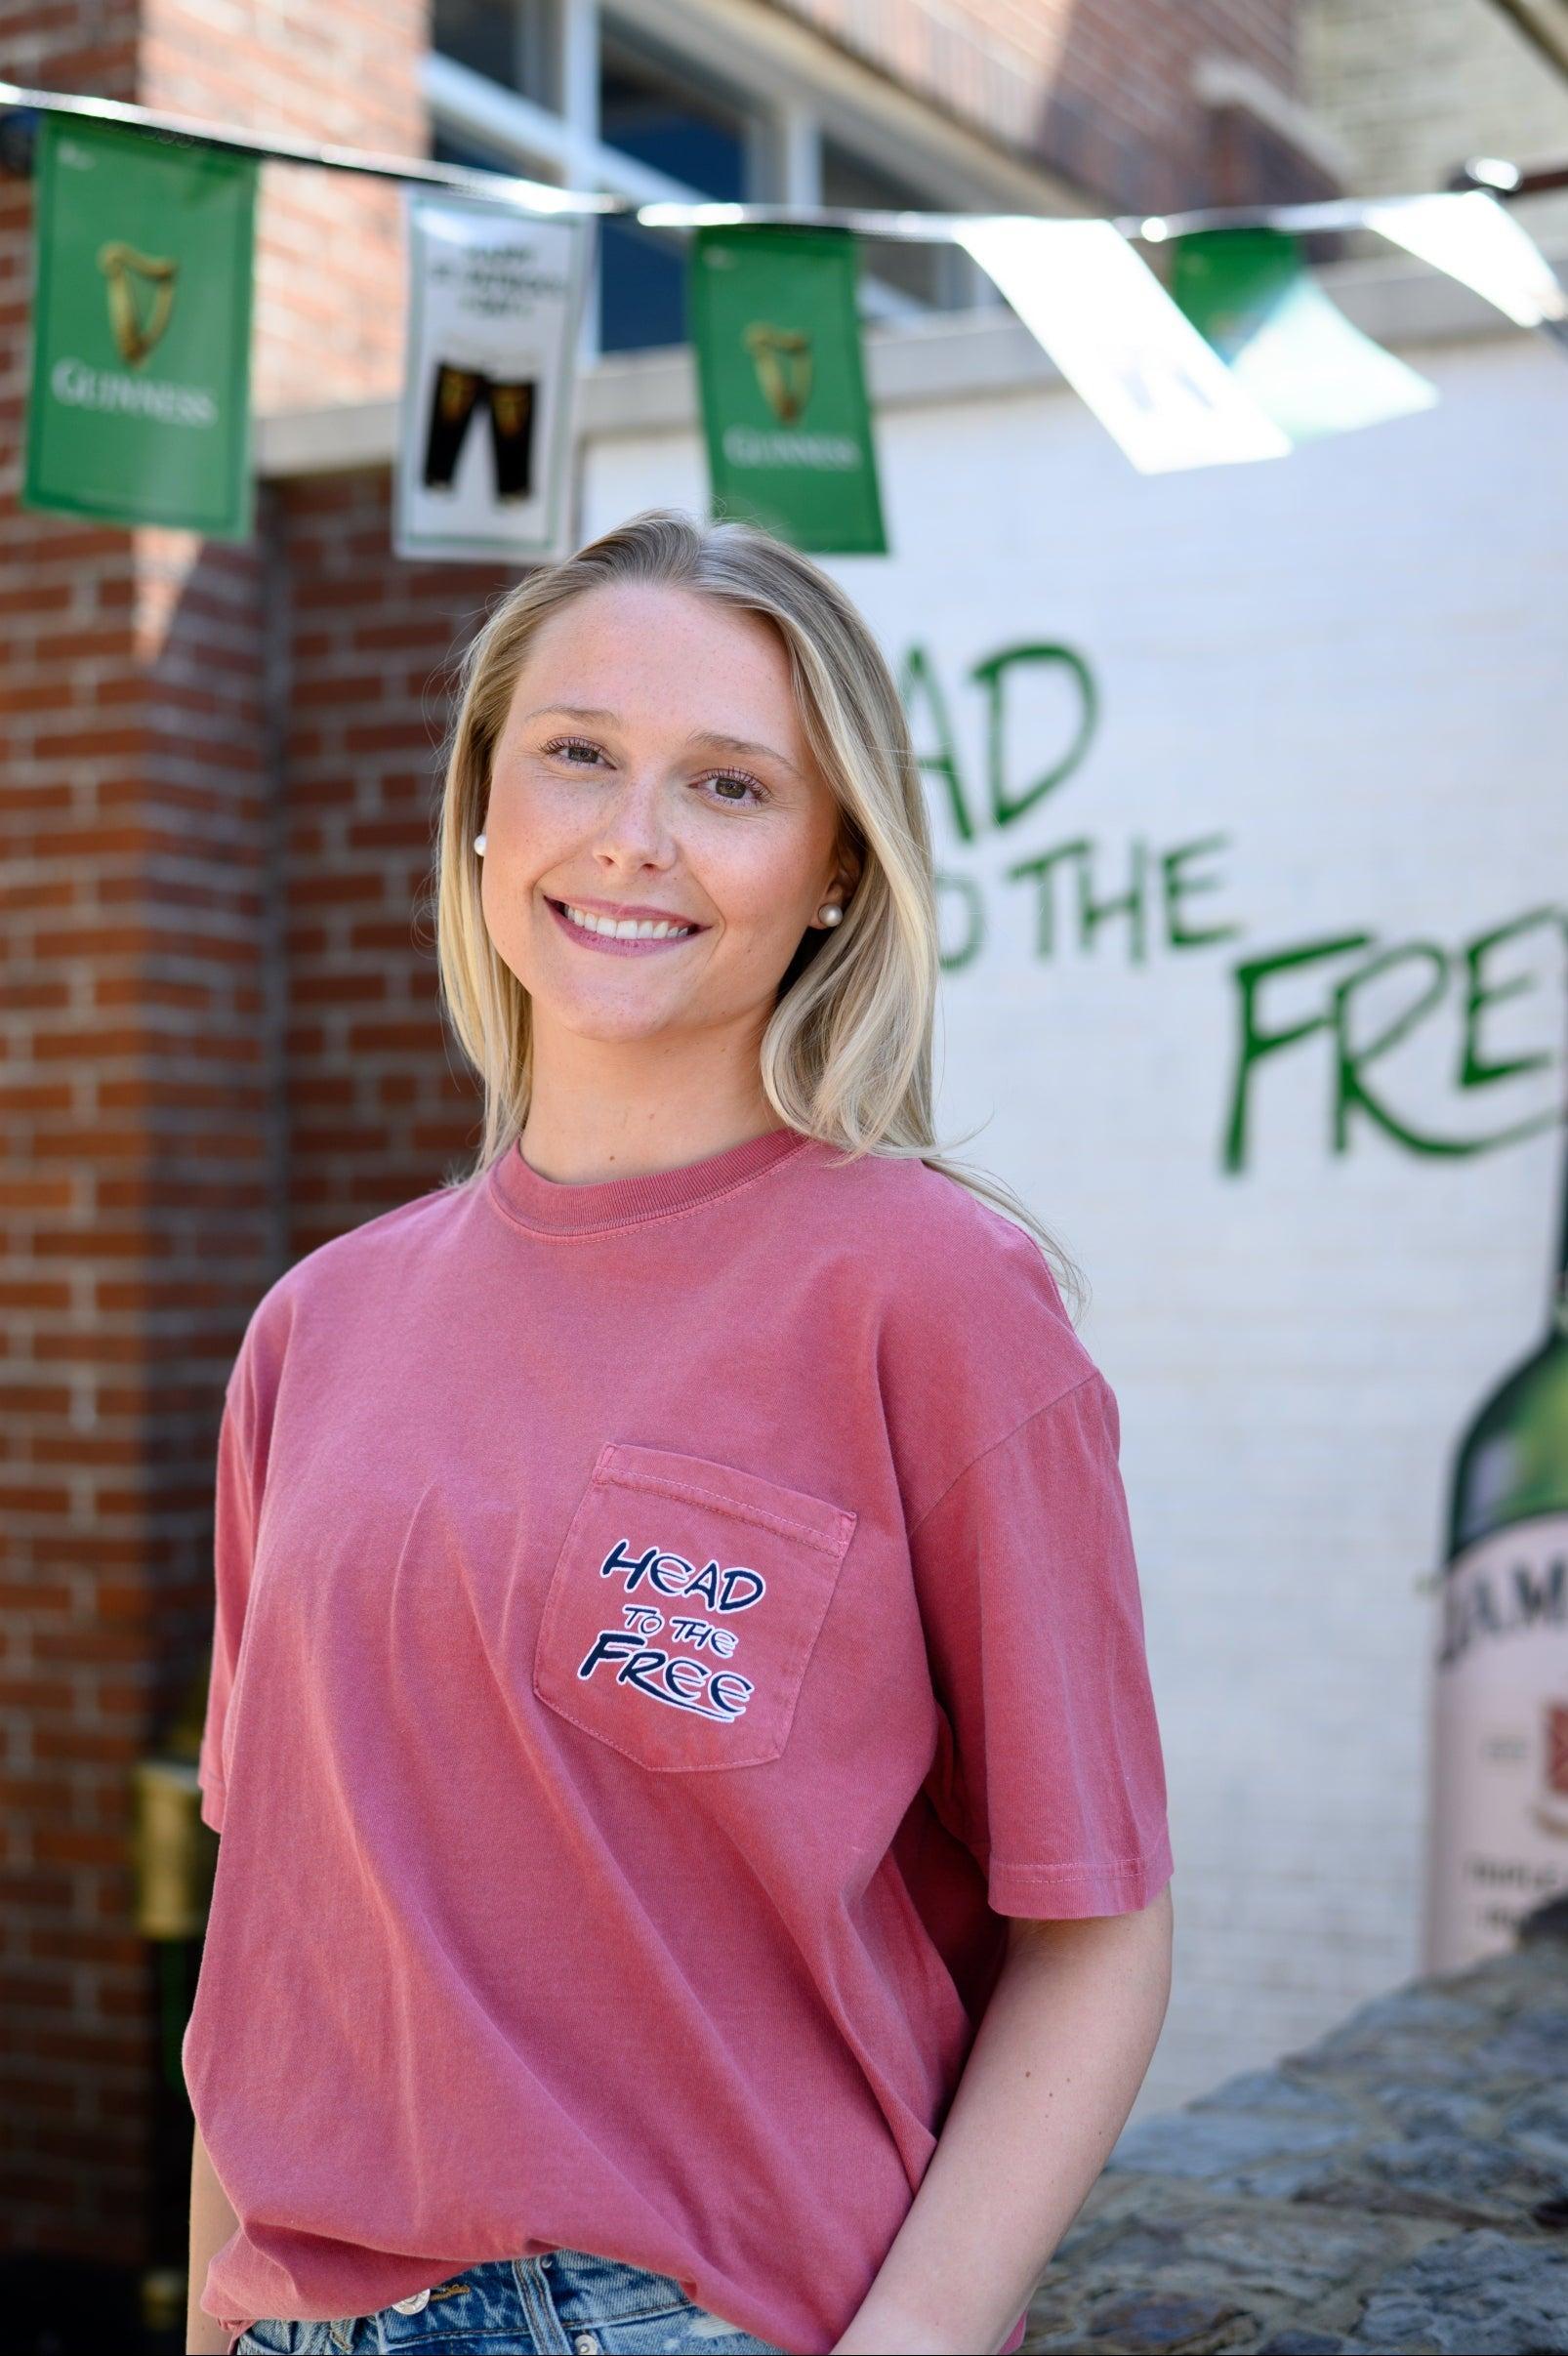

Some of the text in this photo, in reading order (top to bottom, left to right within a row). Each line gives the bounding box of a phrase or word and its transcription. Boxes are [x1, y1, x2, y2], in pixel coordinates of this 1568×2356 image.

[51, 358, 219, 429] GUINNESS
[1005, 830, 1246, 969] THE
[1220, 908, 1568, 1178] FRE
[599, 1539, 766, 1613] HEAD
[623, 1604, 739, 1658] TO THE
[577, 1631, 755, 1723] FREE
